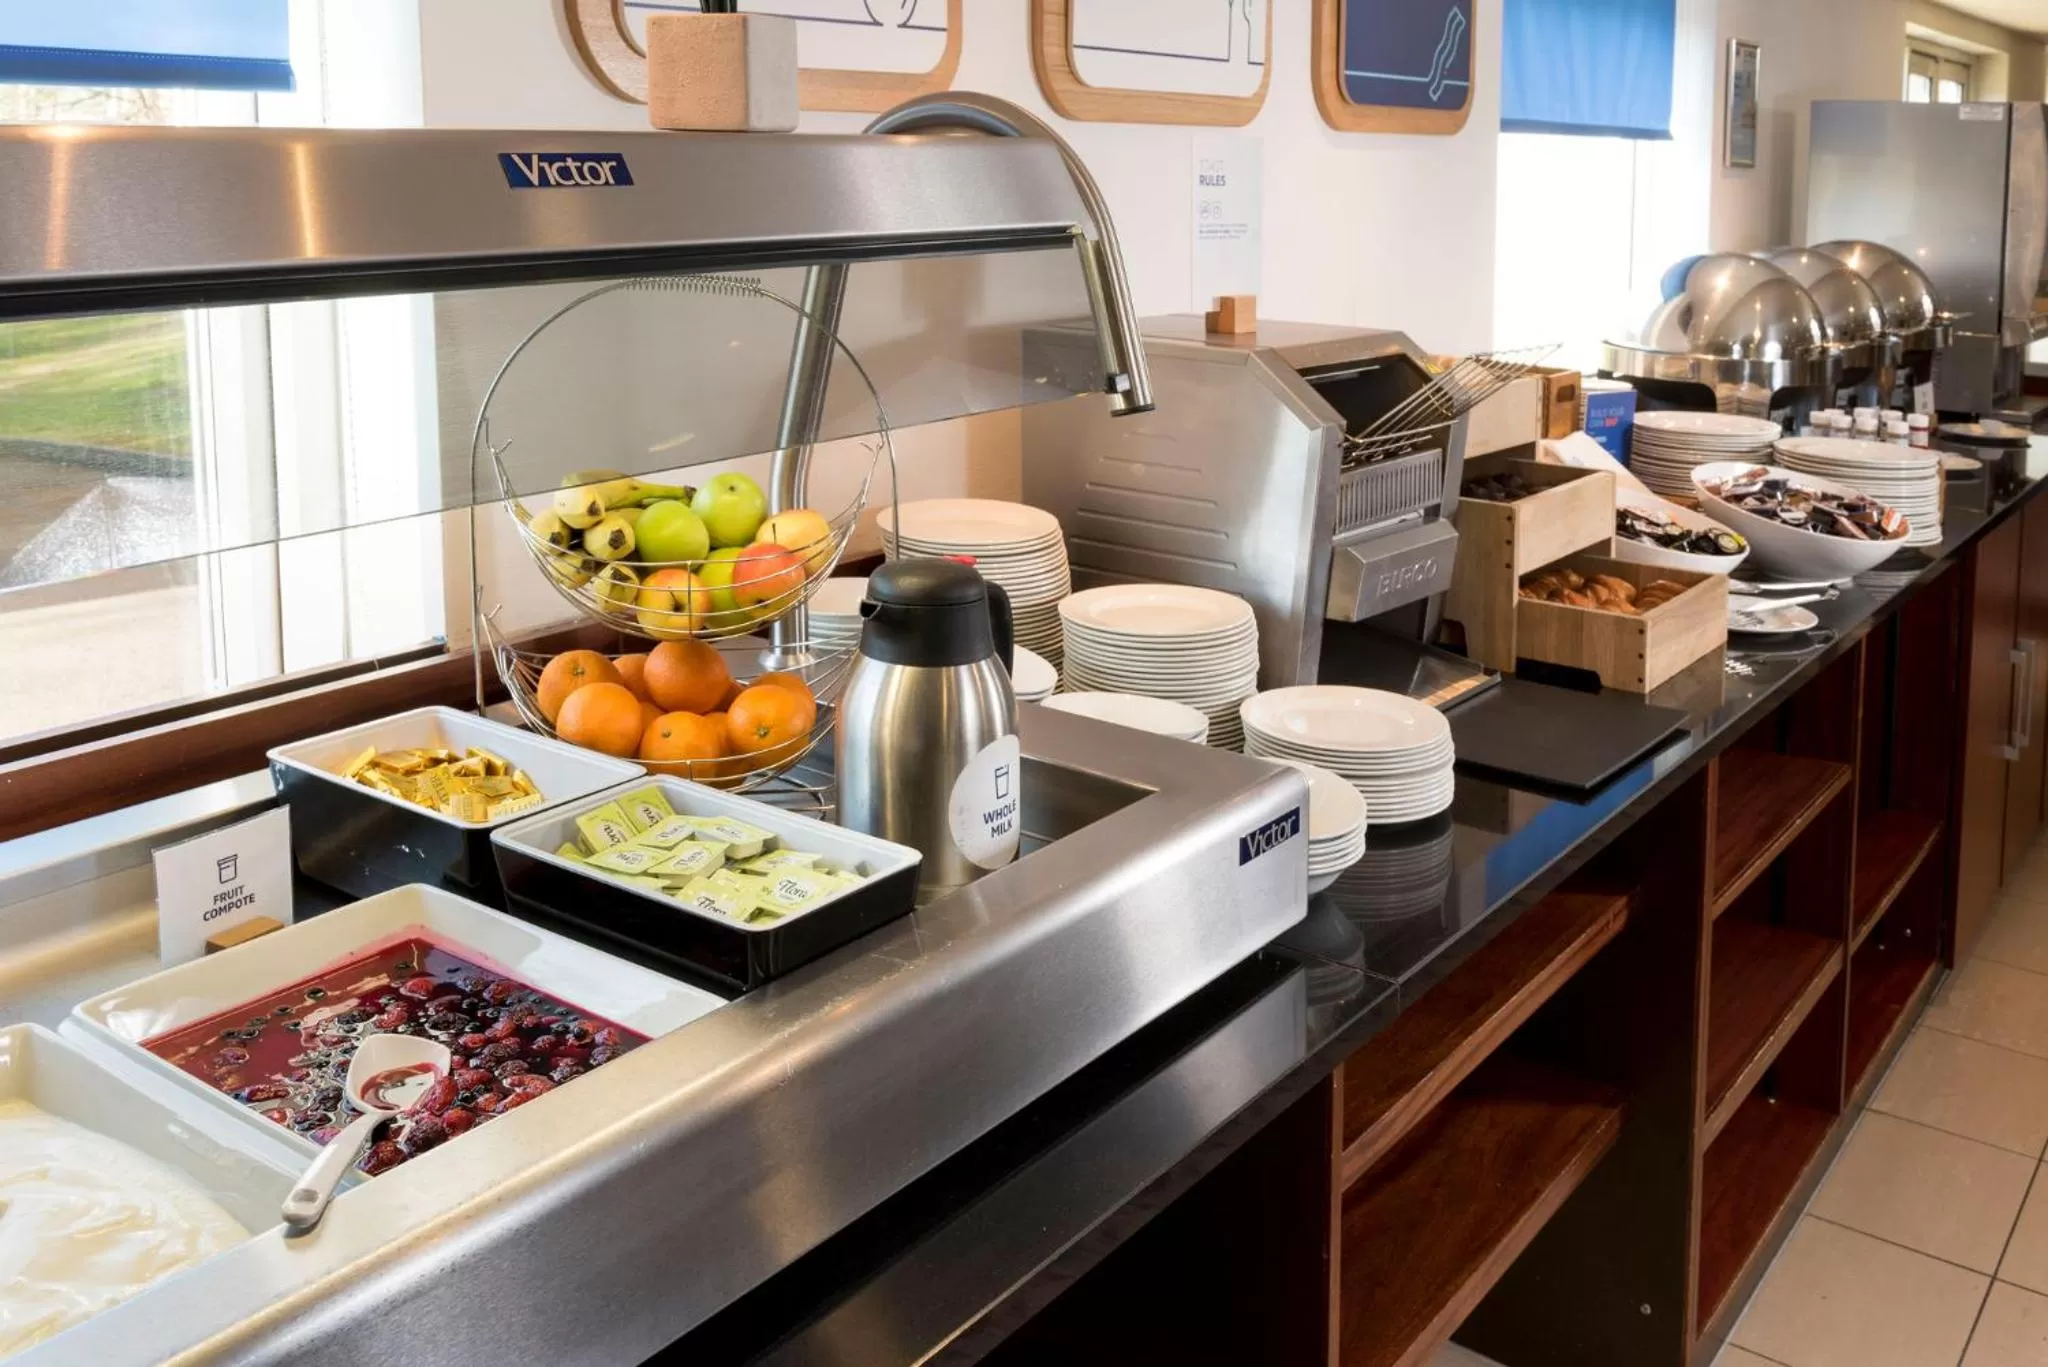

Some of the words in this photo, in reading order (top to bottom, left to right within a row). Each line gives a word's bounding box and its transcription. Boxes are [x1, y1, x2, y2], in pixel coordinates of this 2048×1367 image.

[510, 153, 617, 187] Victor
[1199, 174, 1227, 187] RULES
[983, 799, 1017, 825] WHOLE
[990, 819, 1013, 839] MILK
[1246, 816, 1296, 859] Victor
[202, 893, 256, 922] COMPOTE
[213, 885, 245, 905] FRUIT
